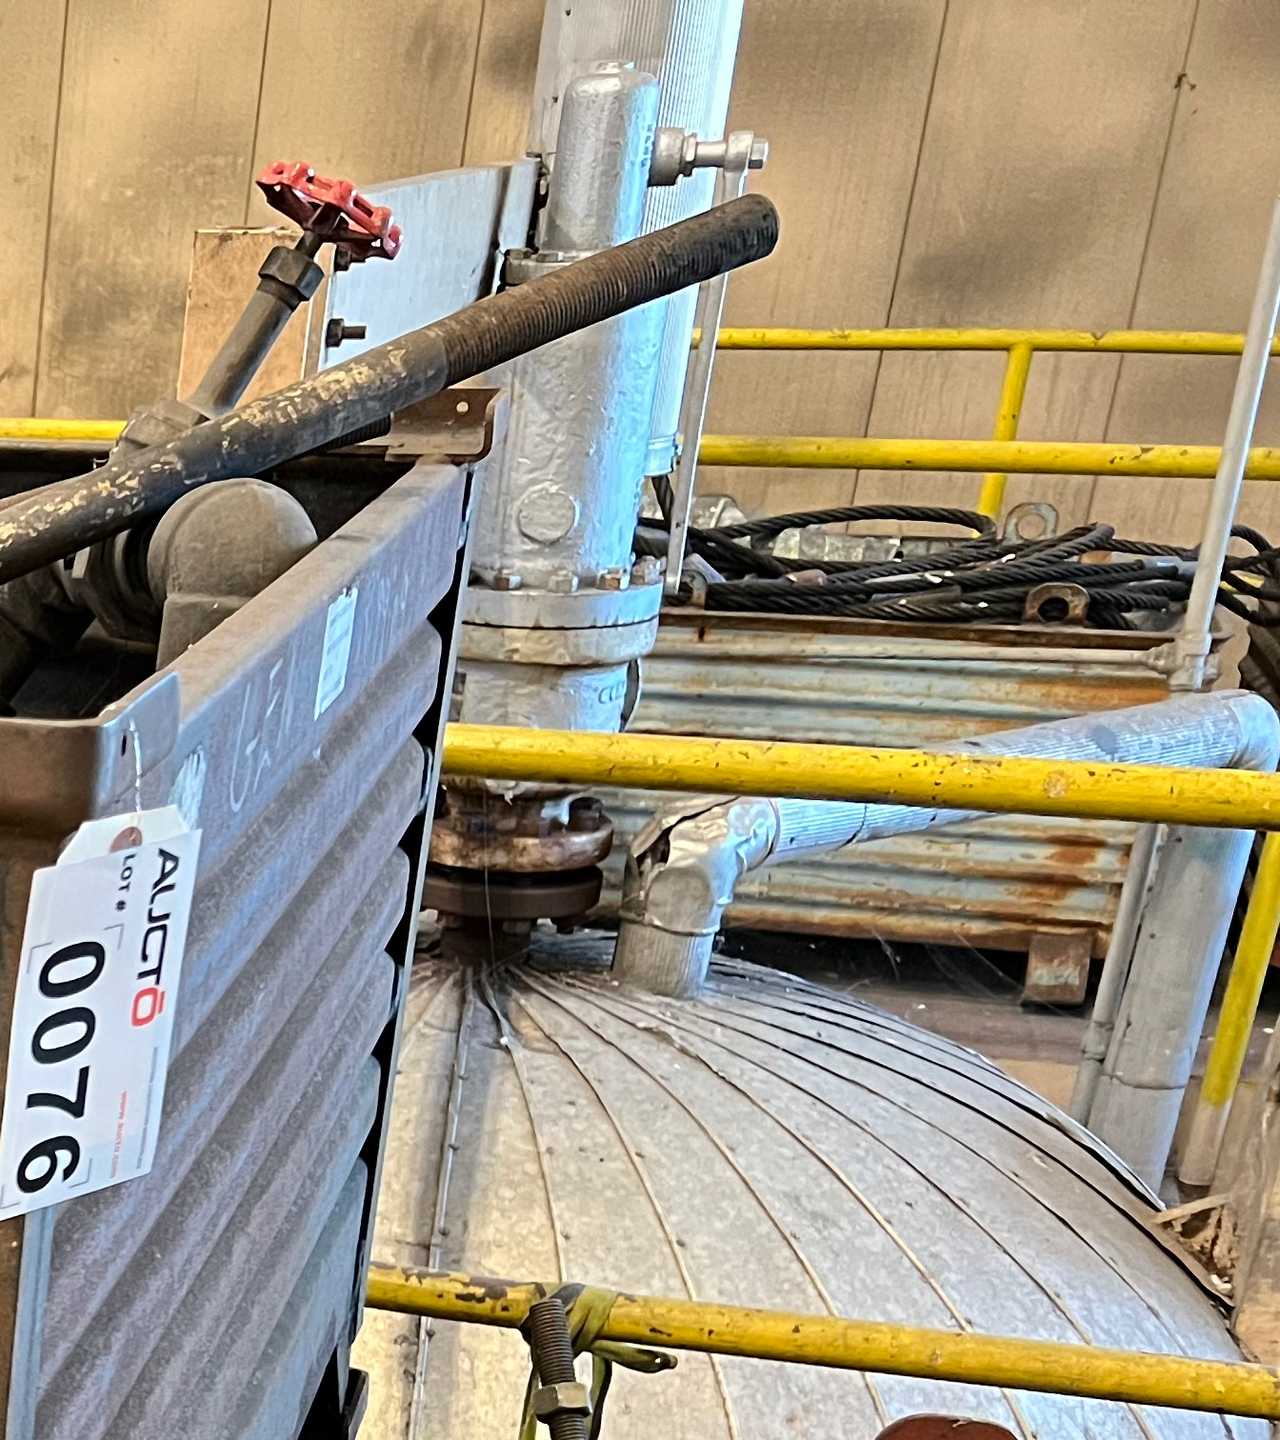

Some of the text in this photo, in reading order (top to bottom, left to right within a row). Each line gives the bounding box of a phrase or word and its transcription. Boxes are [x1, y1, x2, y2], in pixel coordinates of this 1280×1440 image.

[117, 853, 137, 893] LOT
[130, 847, 180, 1027] AUCTO
[15, 940, 106, 1194] 0076
